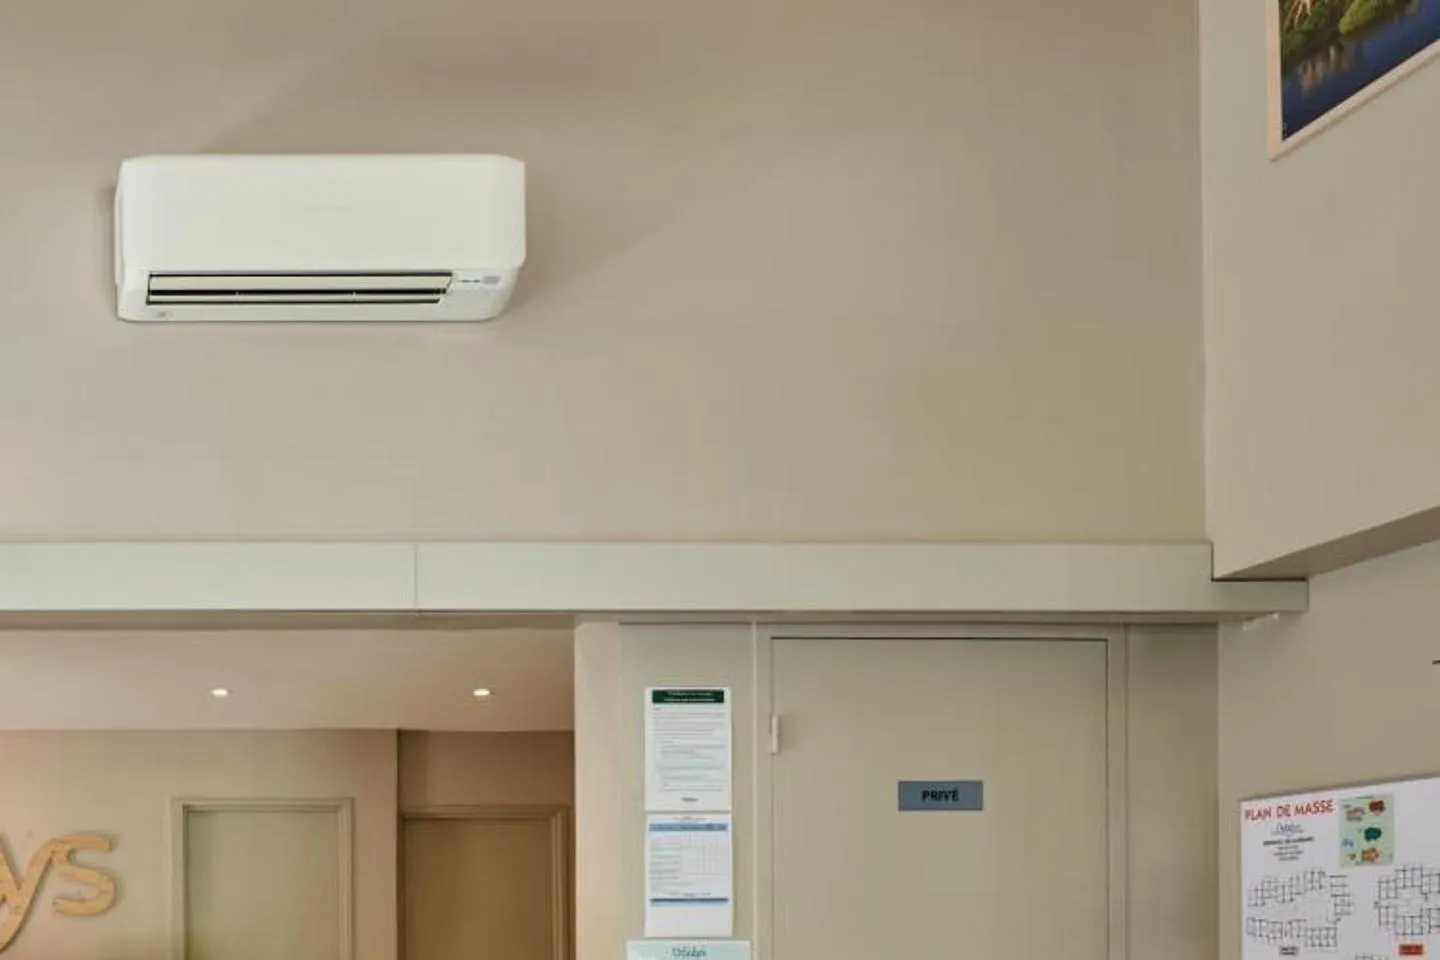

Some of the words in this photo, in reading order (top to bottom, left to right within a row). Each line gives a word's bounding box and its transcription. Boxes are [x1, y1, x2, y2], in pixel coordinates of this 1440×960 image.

[922, 788, 959, 802] PRIVÉ
[1245, 807, 1272, 821] PLAN
[1276, 803, 1291, 818] DE
[1295, 799, 1334, 816] MASSE
